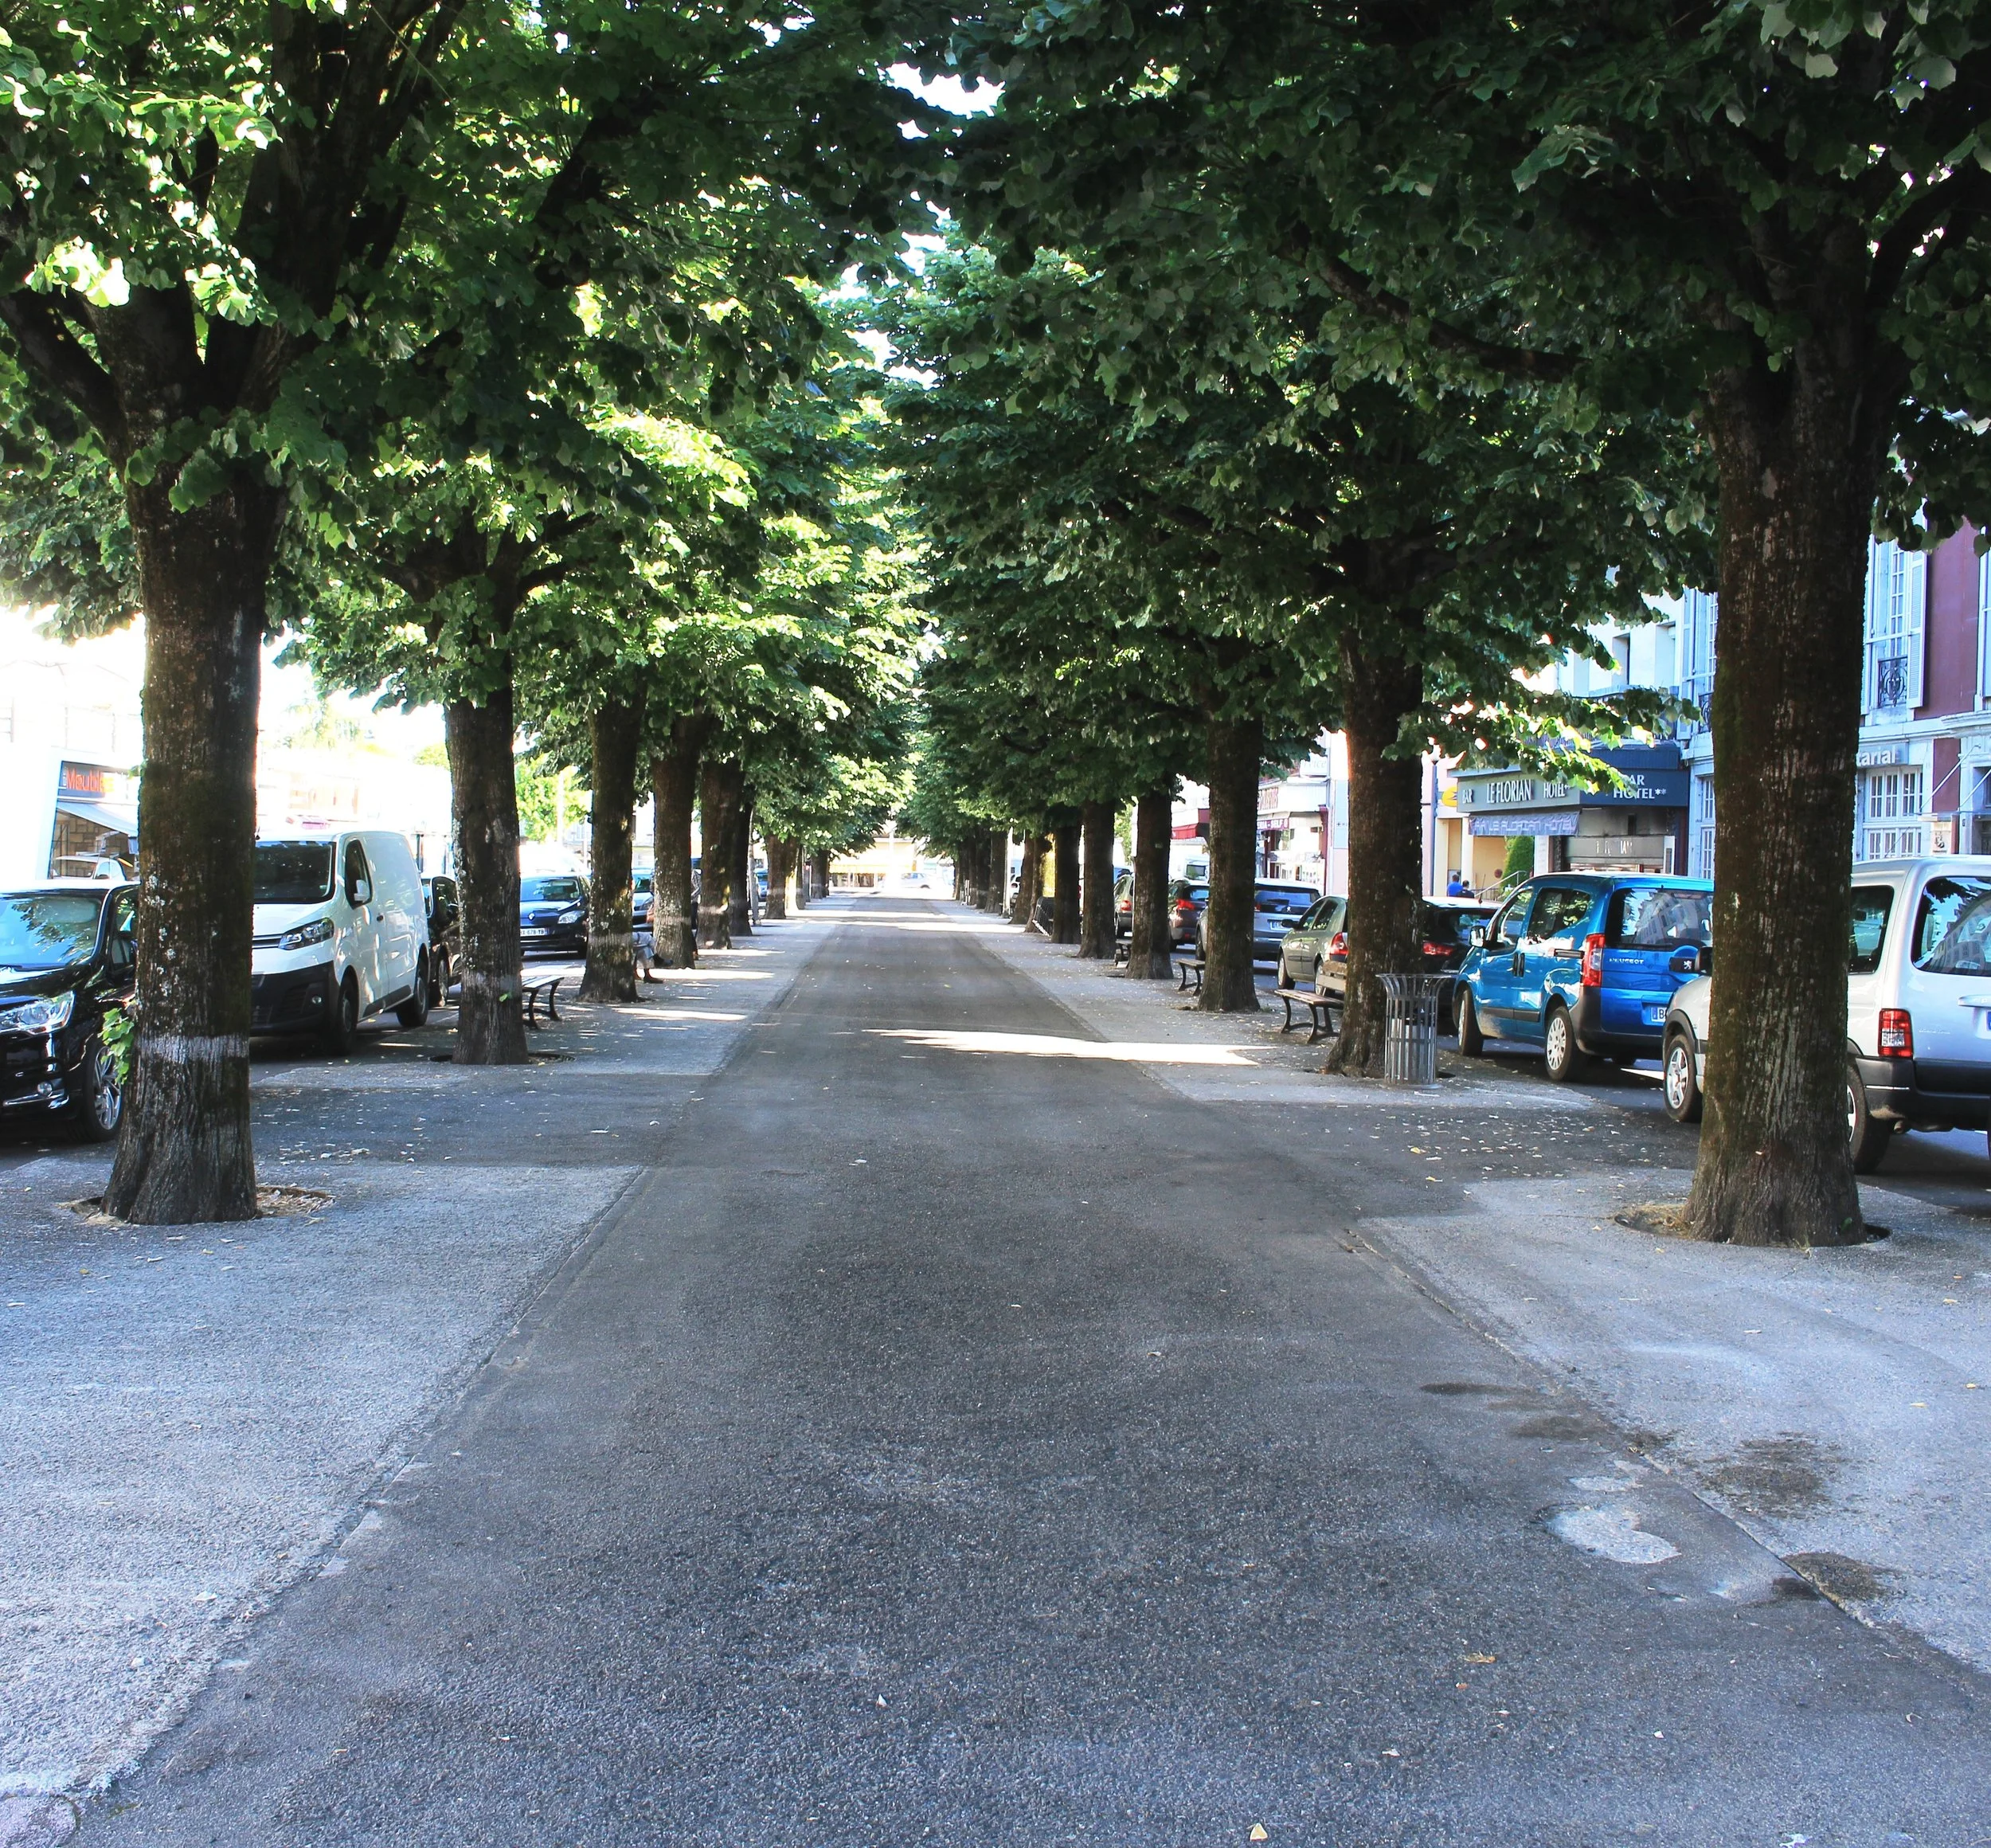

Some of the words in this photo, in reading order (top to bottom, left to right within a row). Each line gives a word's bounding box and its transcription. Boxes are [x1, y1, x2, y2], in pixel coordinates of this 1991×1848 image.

[1462, 789, 1473, 804] BAR
[1486, 783, 1496, 804] LE
[1496, 779, 1532, 803] FLORIAN
